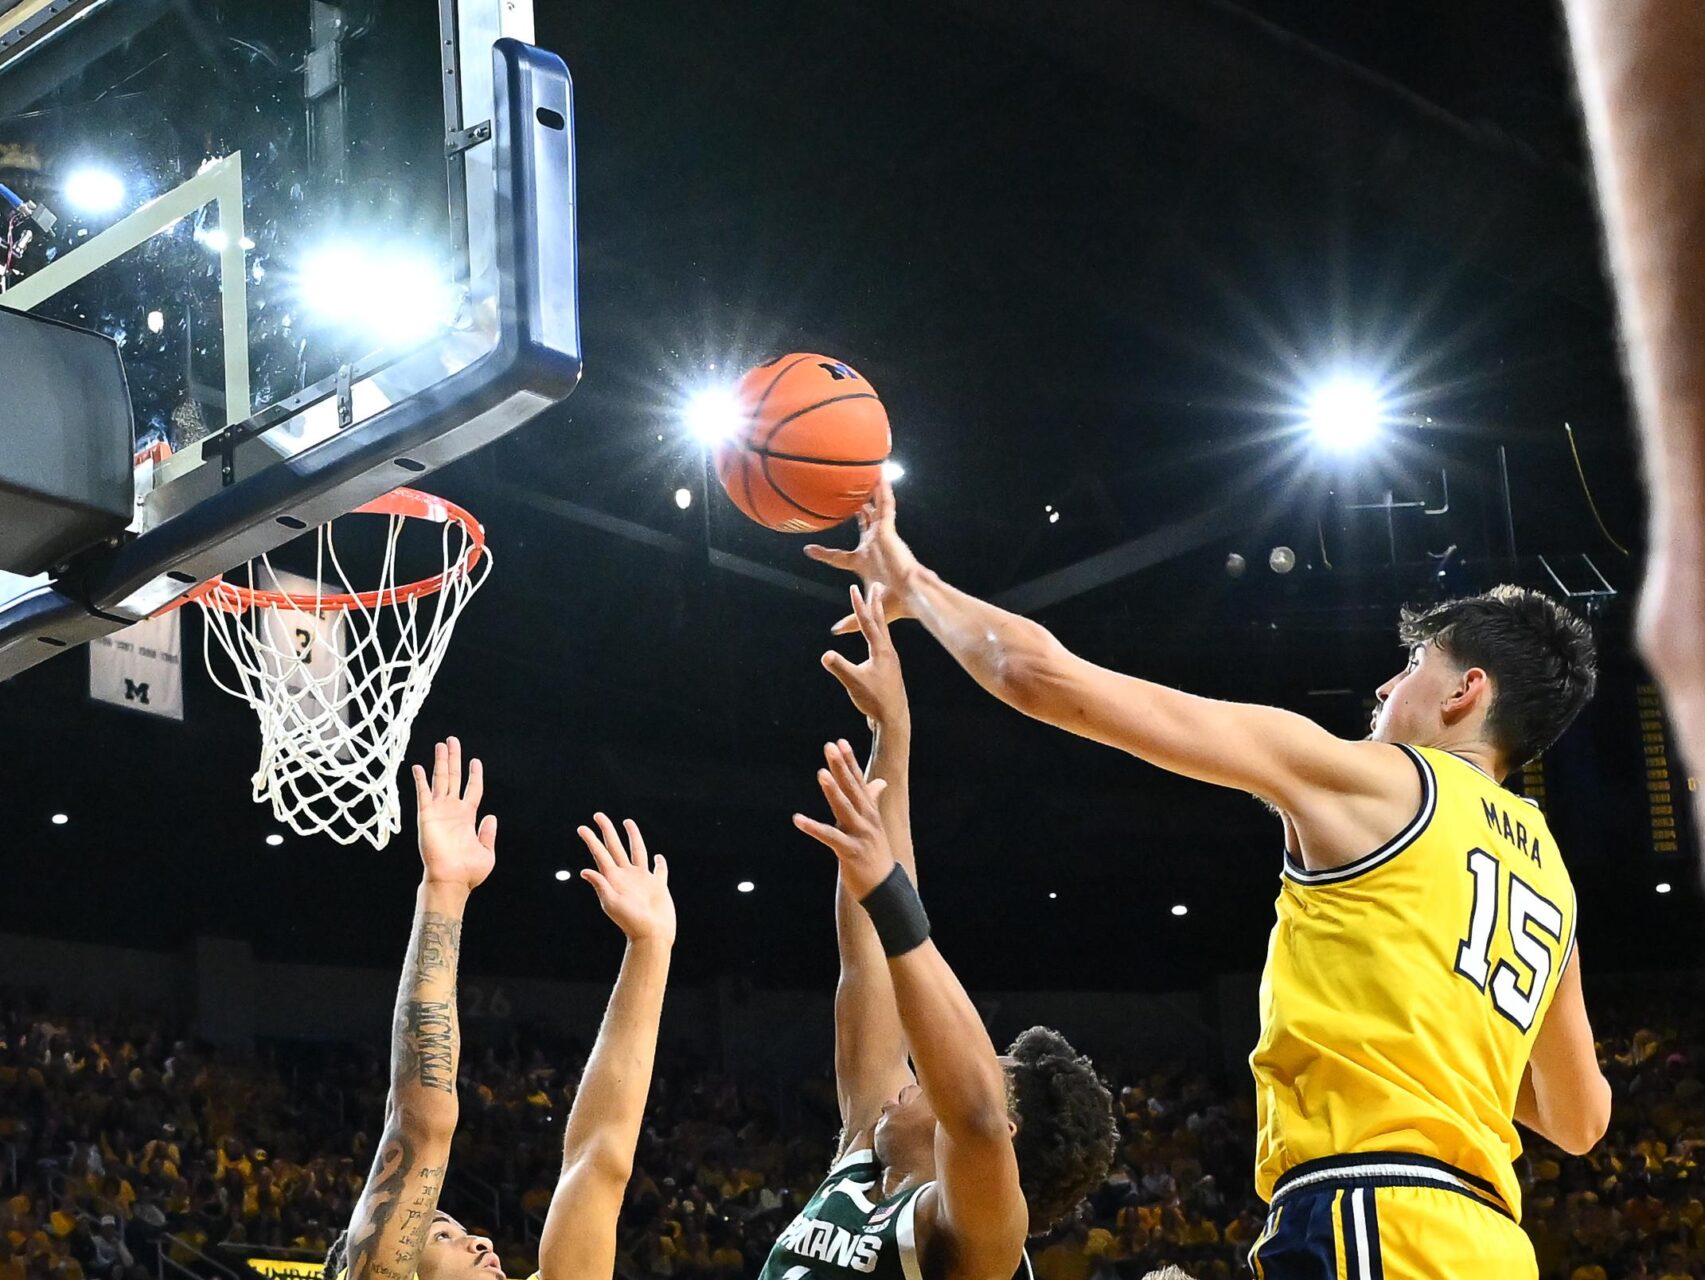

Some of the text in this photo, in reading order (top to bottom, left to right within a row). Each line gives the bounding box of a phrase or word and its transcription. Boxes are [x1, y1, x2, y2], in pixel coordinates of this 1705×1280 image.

[124, 678, 150, 705] M
[1480, 796, 1542, 869] MARA
[1454, 846, 1563, 1016] 15
